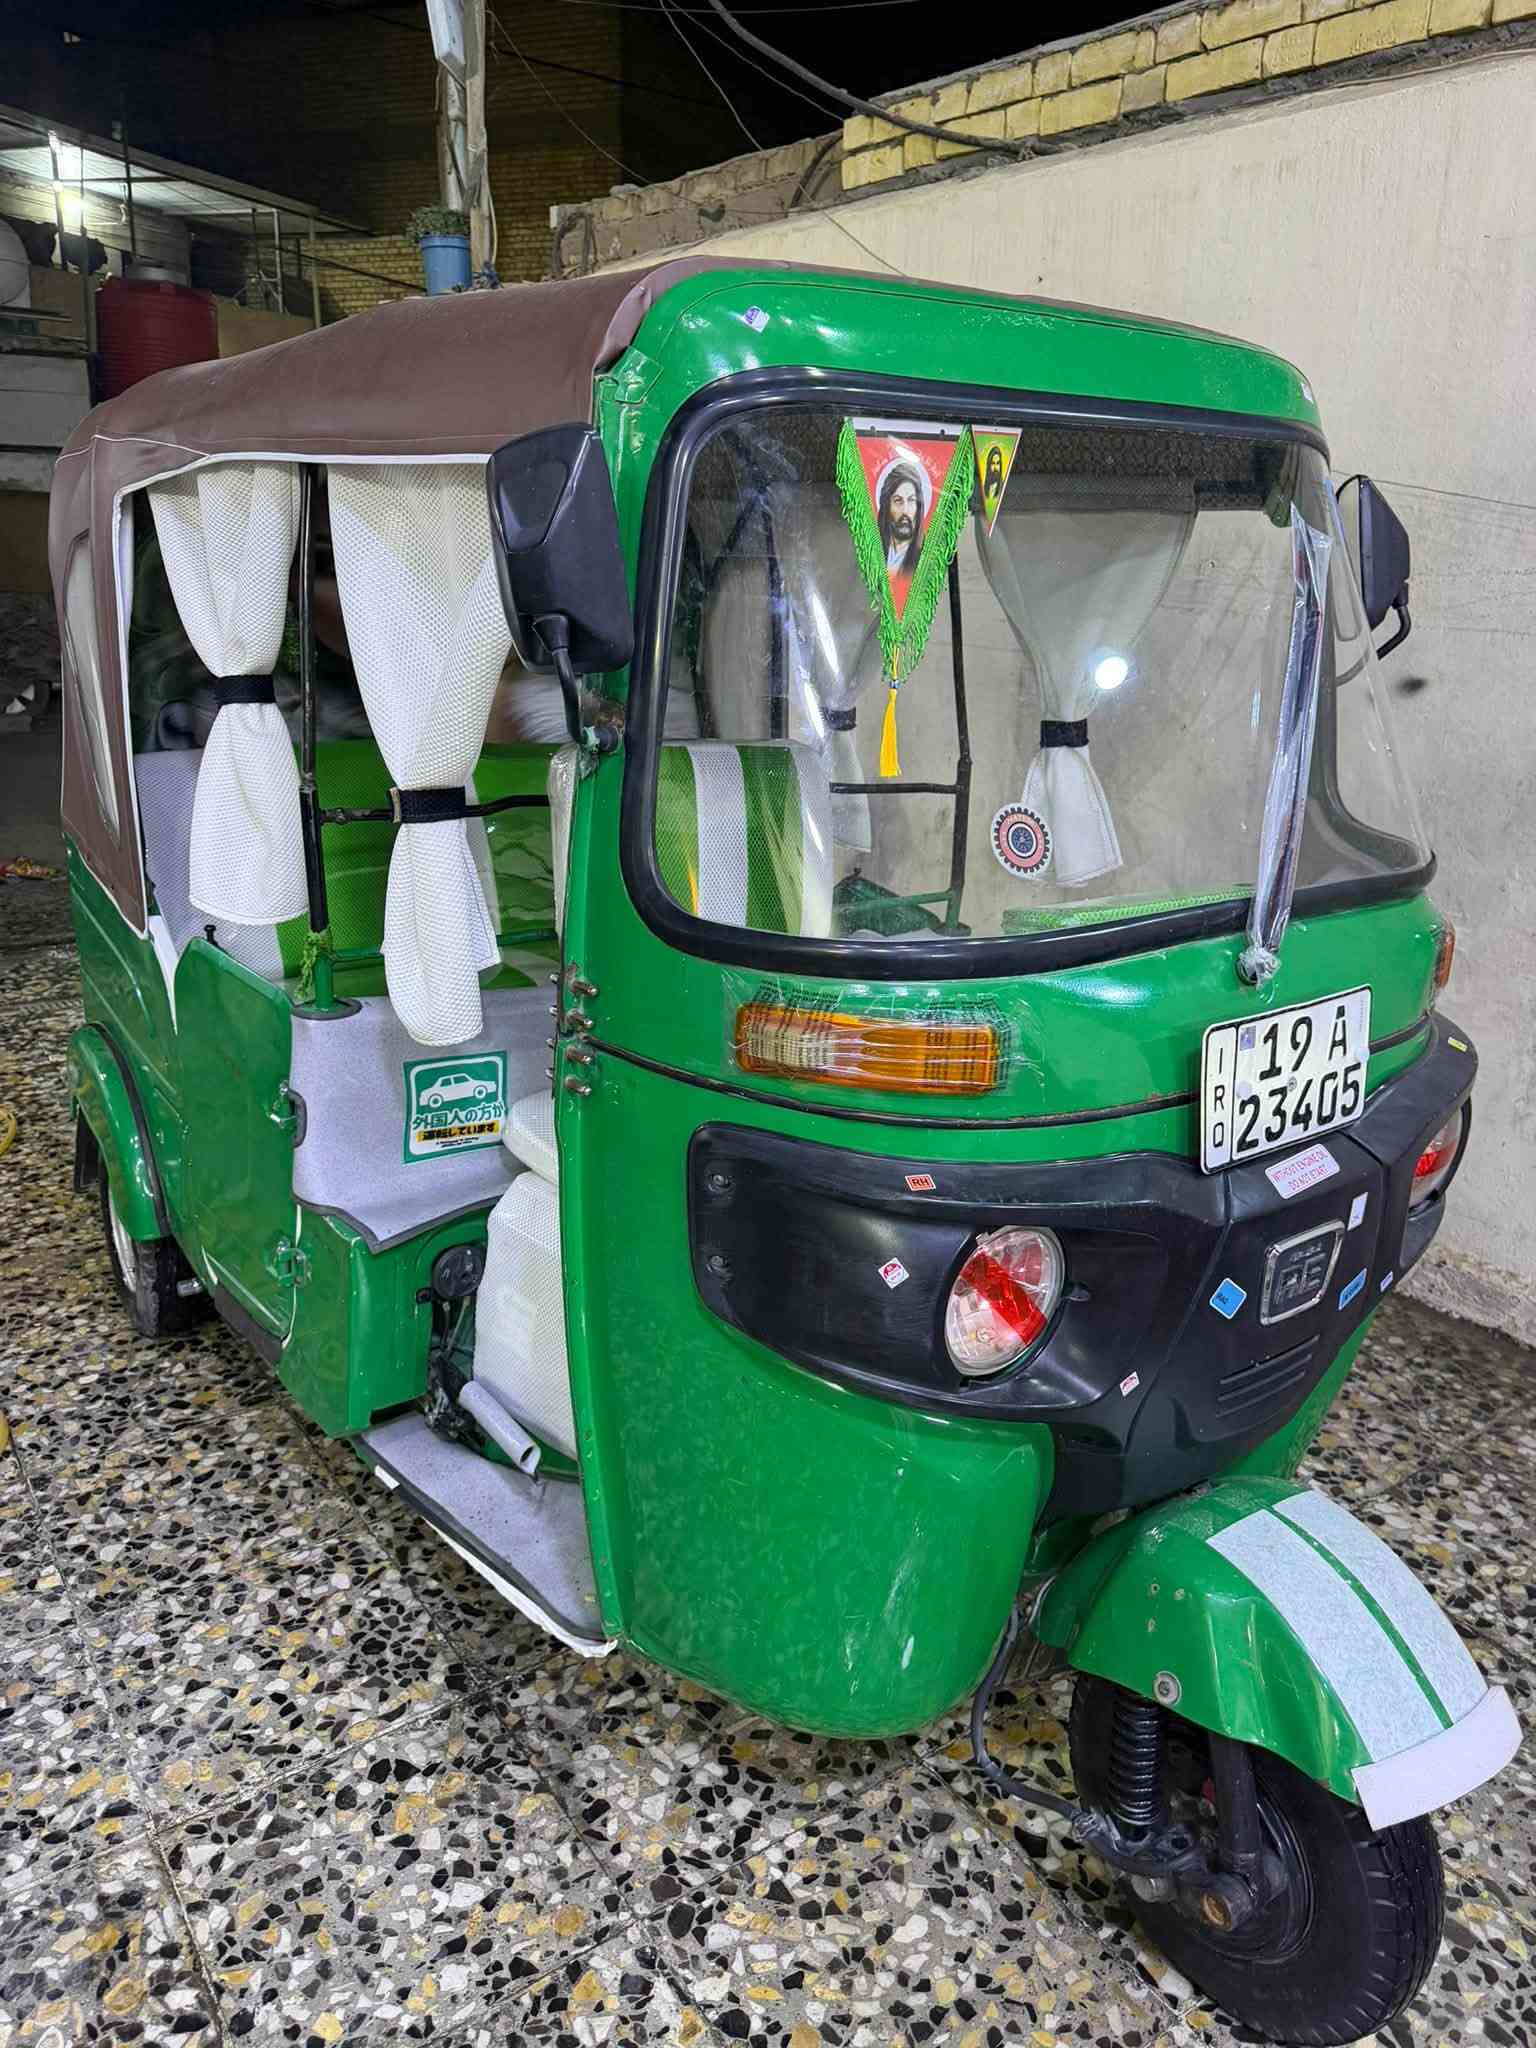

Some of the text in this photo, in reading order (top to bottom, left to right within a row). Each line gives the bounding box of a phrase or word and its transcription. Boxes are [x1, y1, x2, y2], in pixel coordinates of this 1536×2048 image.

[1259, 1016, 1313, 1081] 19
[412, 1100, 504, 1130] 外国人の方が
[1236, 1062, 1362, 1153] 23405
[911, 1177, 930, 1187] RH
